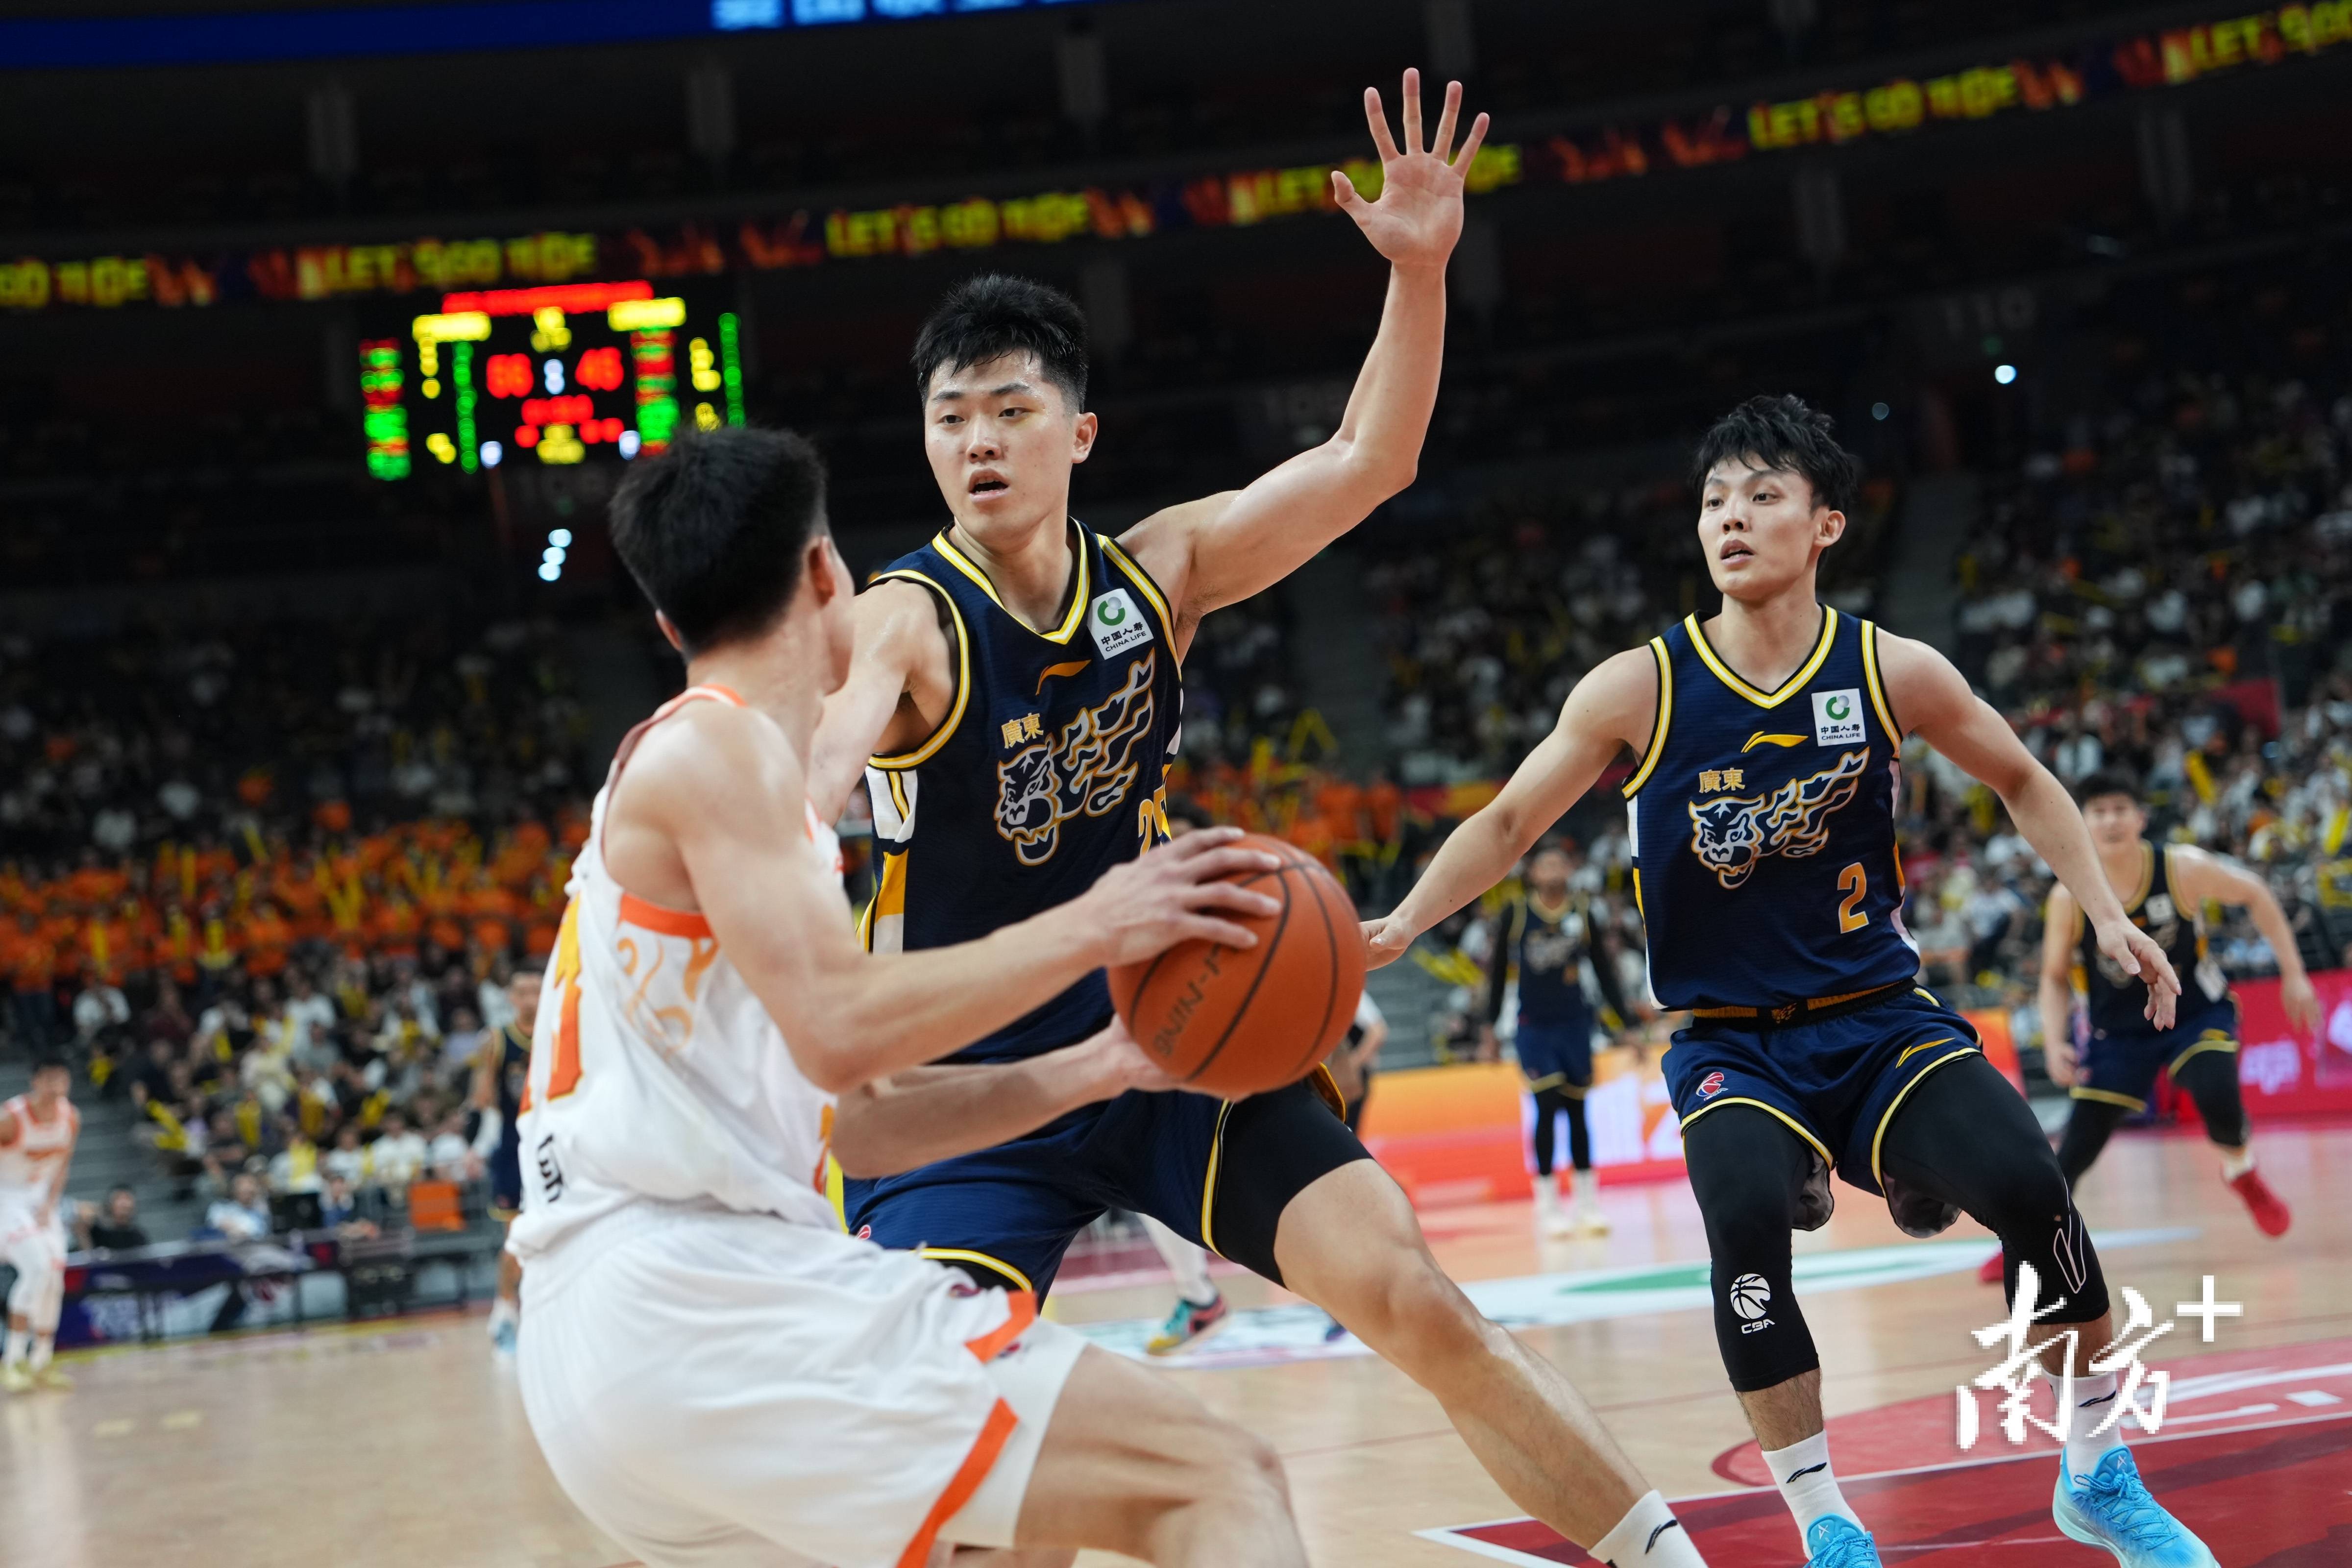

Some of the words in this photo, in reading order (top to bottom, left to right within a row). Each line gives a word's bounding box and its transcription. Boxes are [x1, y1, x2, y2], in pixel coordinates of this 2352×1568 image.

[1101, 622, 1143, 645] 中国人寿
[1105, 639, 1129, 652] CHINA
[1130, 631, 1147, 641] LIFE
[1001, 712, 1044, 749] 廣東
[1820, 724, 1861, 735] 中国人寿
[1699, 767, 1745, 793] 廣東
[1837, 862, 1869, 934] 2
[1741, 1319, 1776, 1334] CBA
